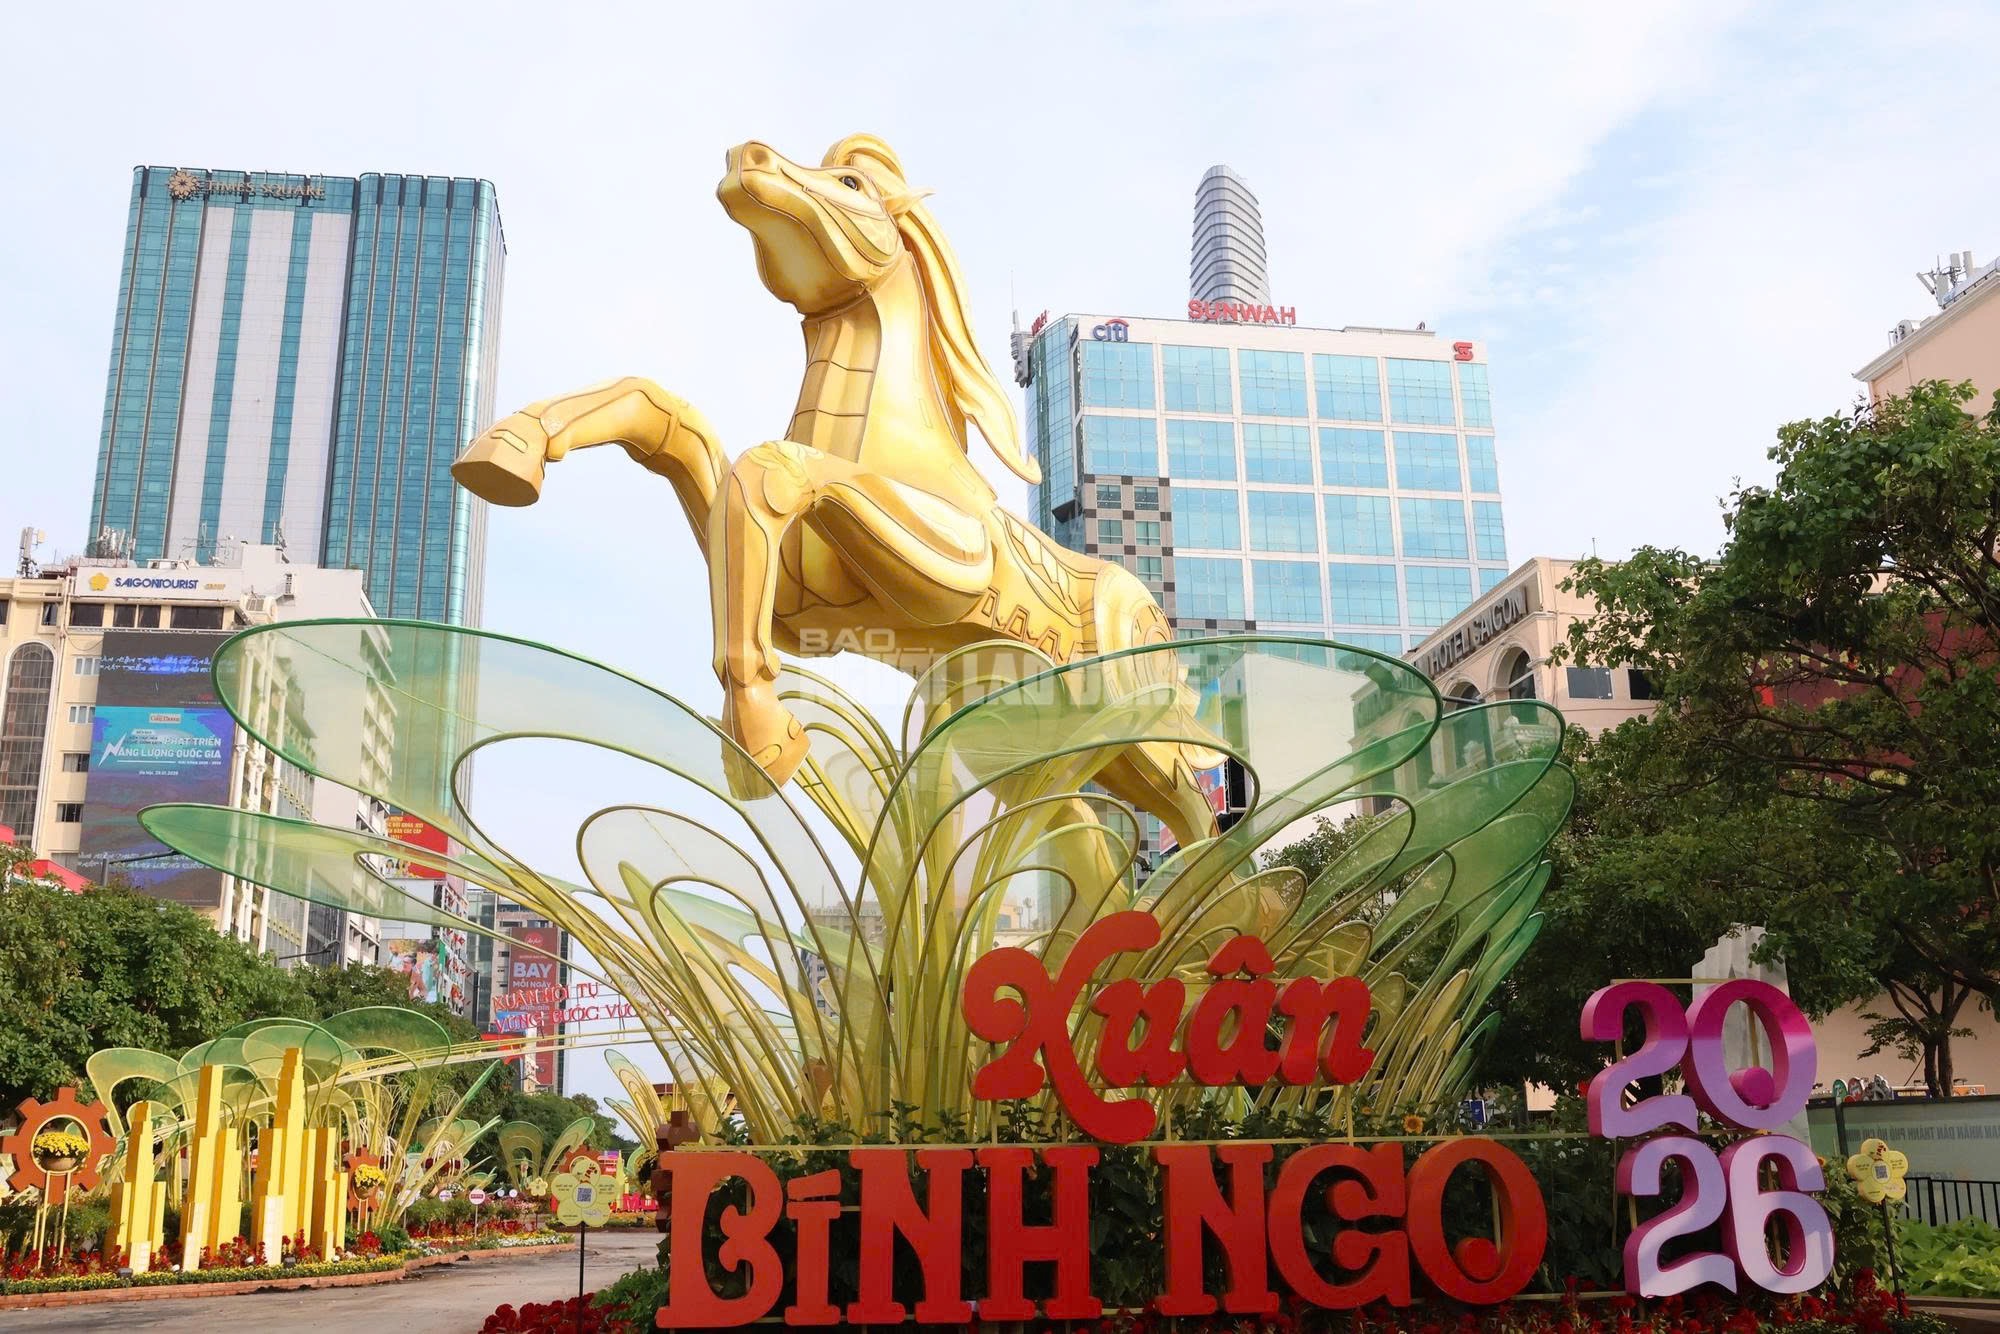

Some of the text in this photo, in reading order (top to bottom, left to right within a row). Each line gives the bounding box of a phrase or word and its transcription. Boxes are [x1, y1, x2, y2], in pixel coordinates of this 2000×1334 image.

[261, 183, 326, 200] SQUARE
[1187, 299, 1296, 325] SUNWAH
[1092, 319, 1130, 342] citi
[114, 577, 199, 590] SAIGONTOURIST
[1431, 628, 1470, 676] HOTEL
[1473, 590, 1524, 643] SAIGON
[204, 749, 221, 759] GIA
[513, 962, 553, 978] BAY
[576, 981, 599, 1000] TỤ
[552, 1003, 599, 1024] BƯỚC
[963, 910, 1376, 1143] Xuân
[1579, 979, 1818, 1139] 20
[1616, 1134, 1836, 1298] 26
[655, 1146, 1104, 1329] BÍNH
